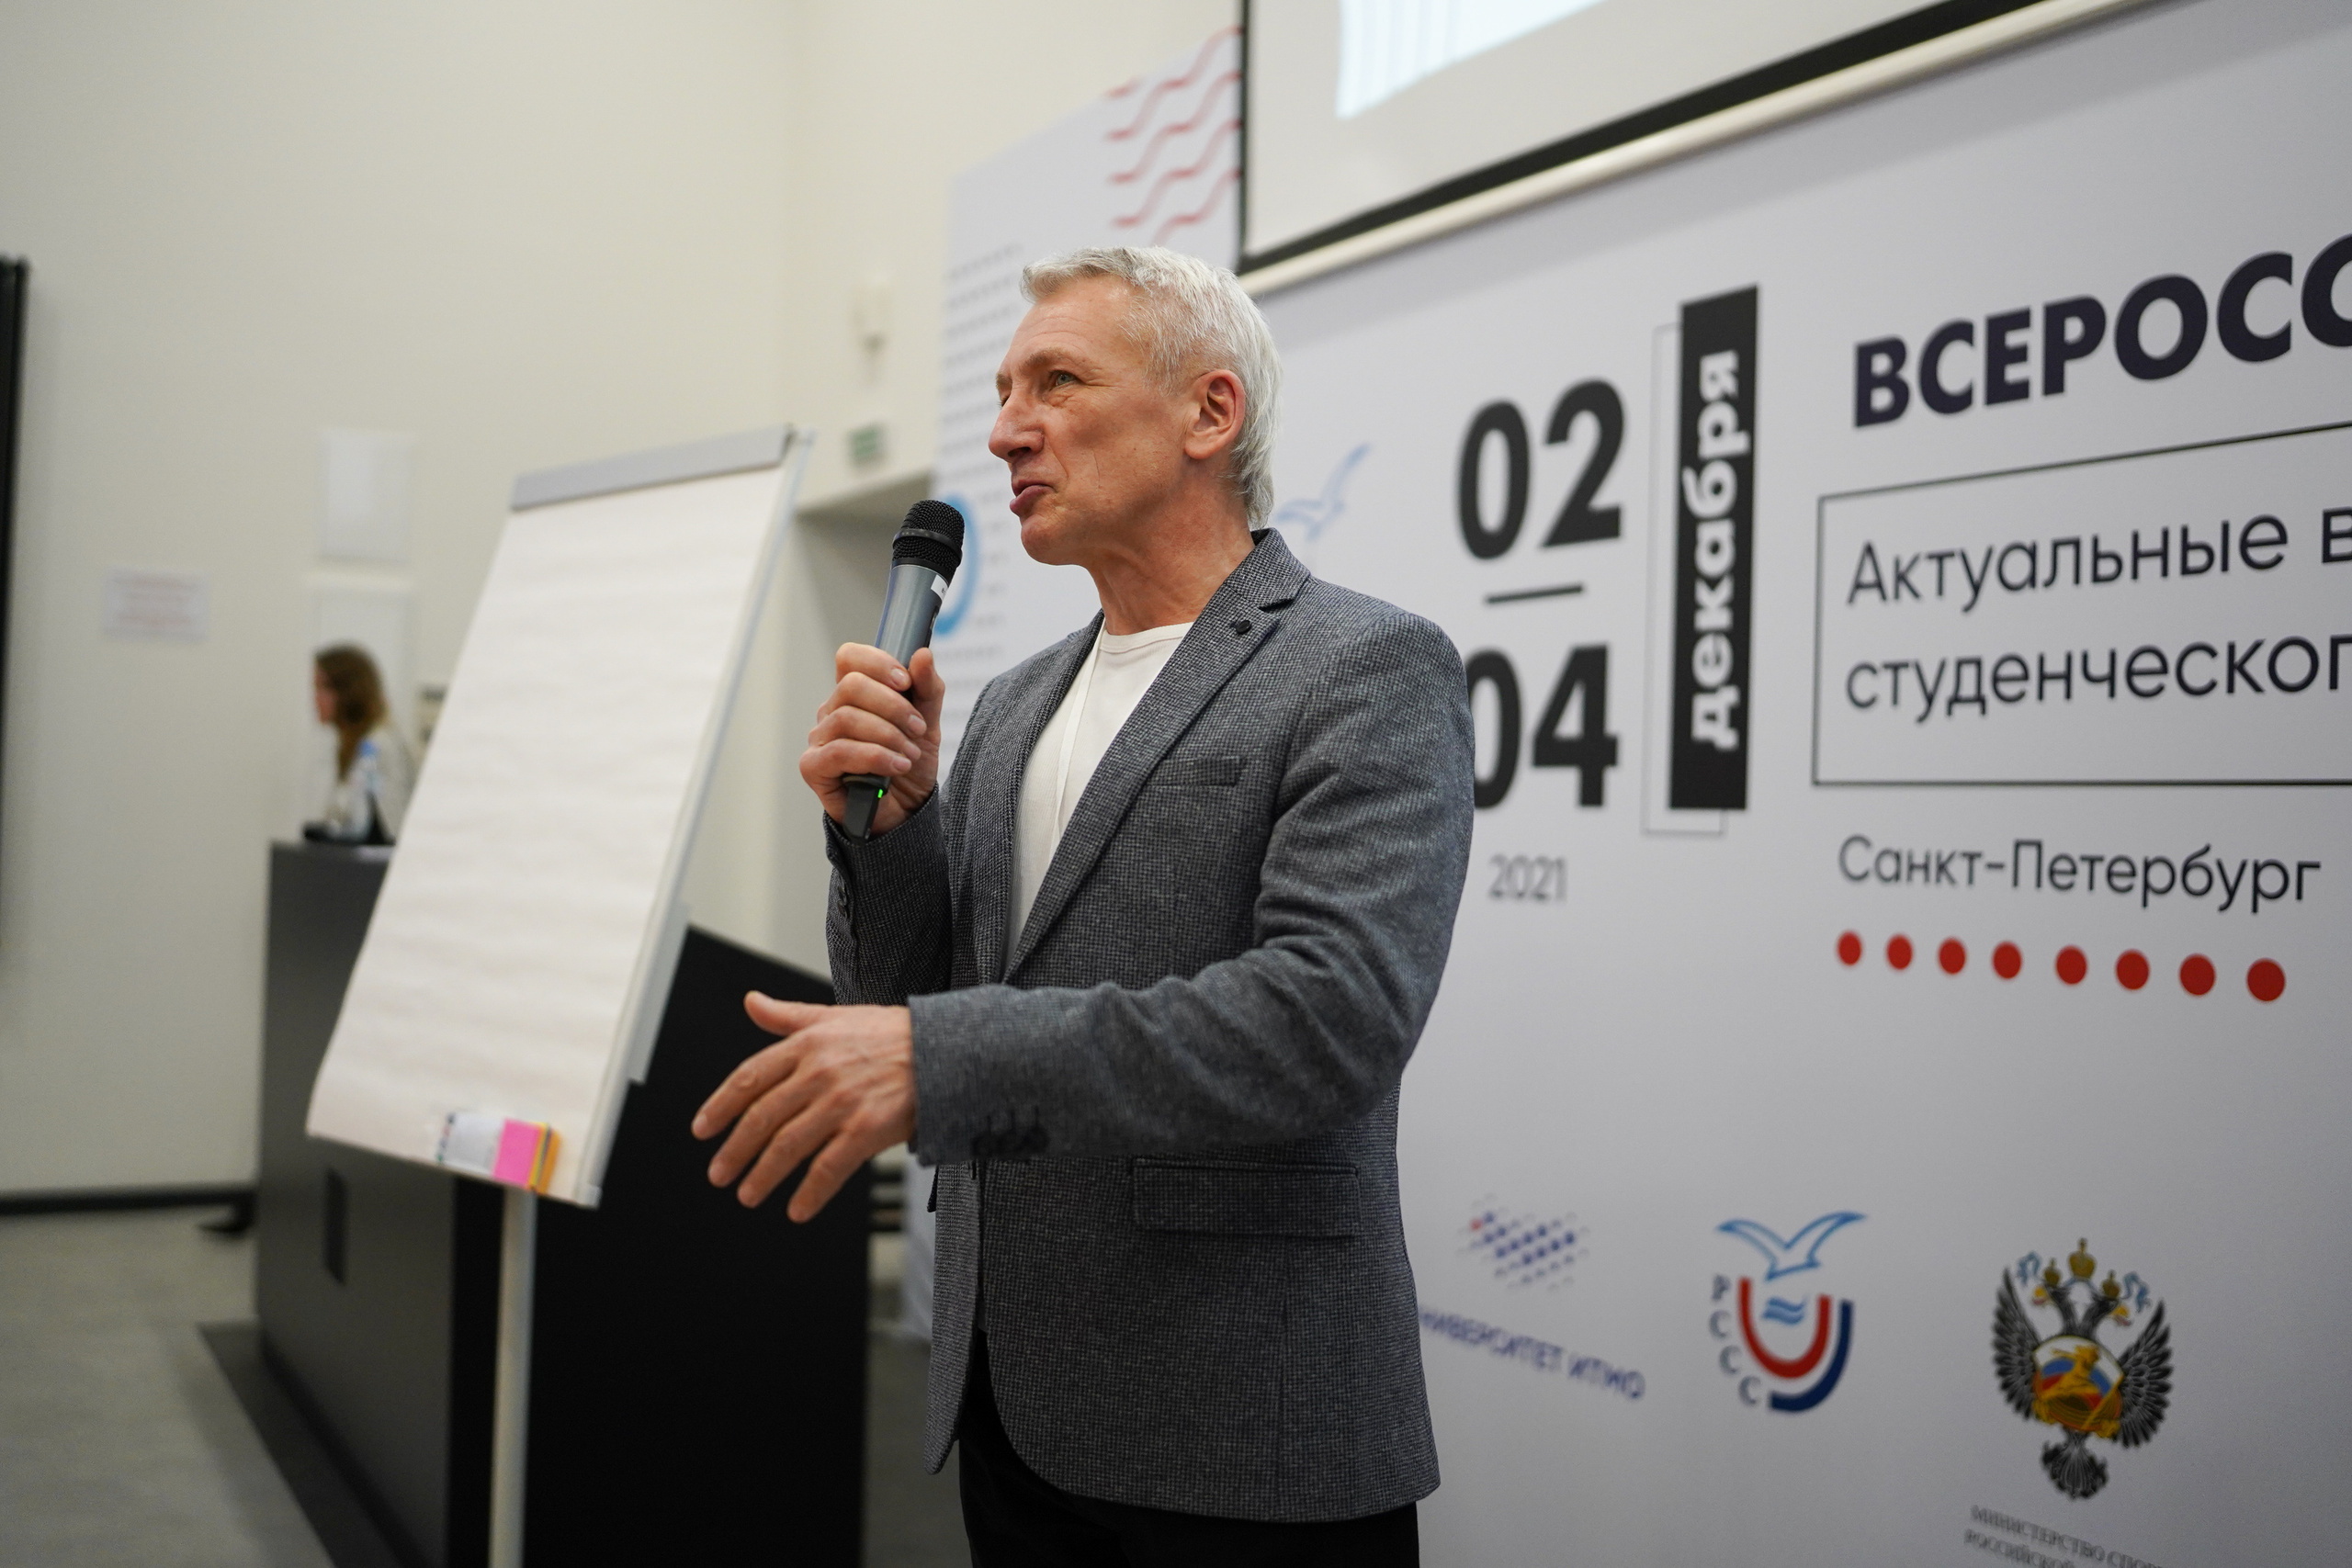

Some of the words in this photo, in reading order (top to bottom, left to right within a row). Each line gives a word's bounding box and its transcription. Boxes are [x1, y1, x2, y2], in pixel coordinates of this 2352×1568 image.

[1456, 378, 1626, 561] 02
[1682, 350, 1750, 751] декабря
[1848, 514, 2289, 613] Актуальные
[1464, 643, 1621, 811] 04
[1488, 853, 1567, 904] 2021
[1839, 835, 2322, 915] Санкт-Петербург
